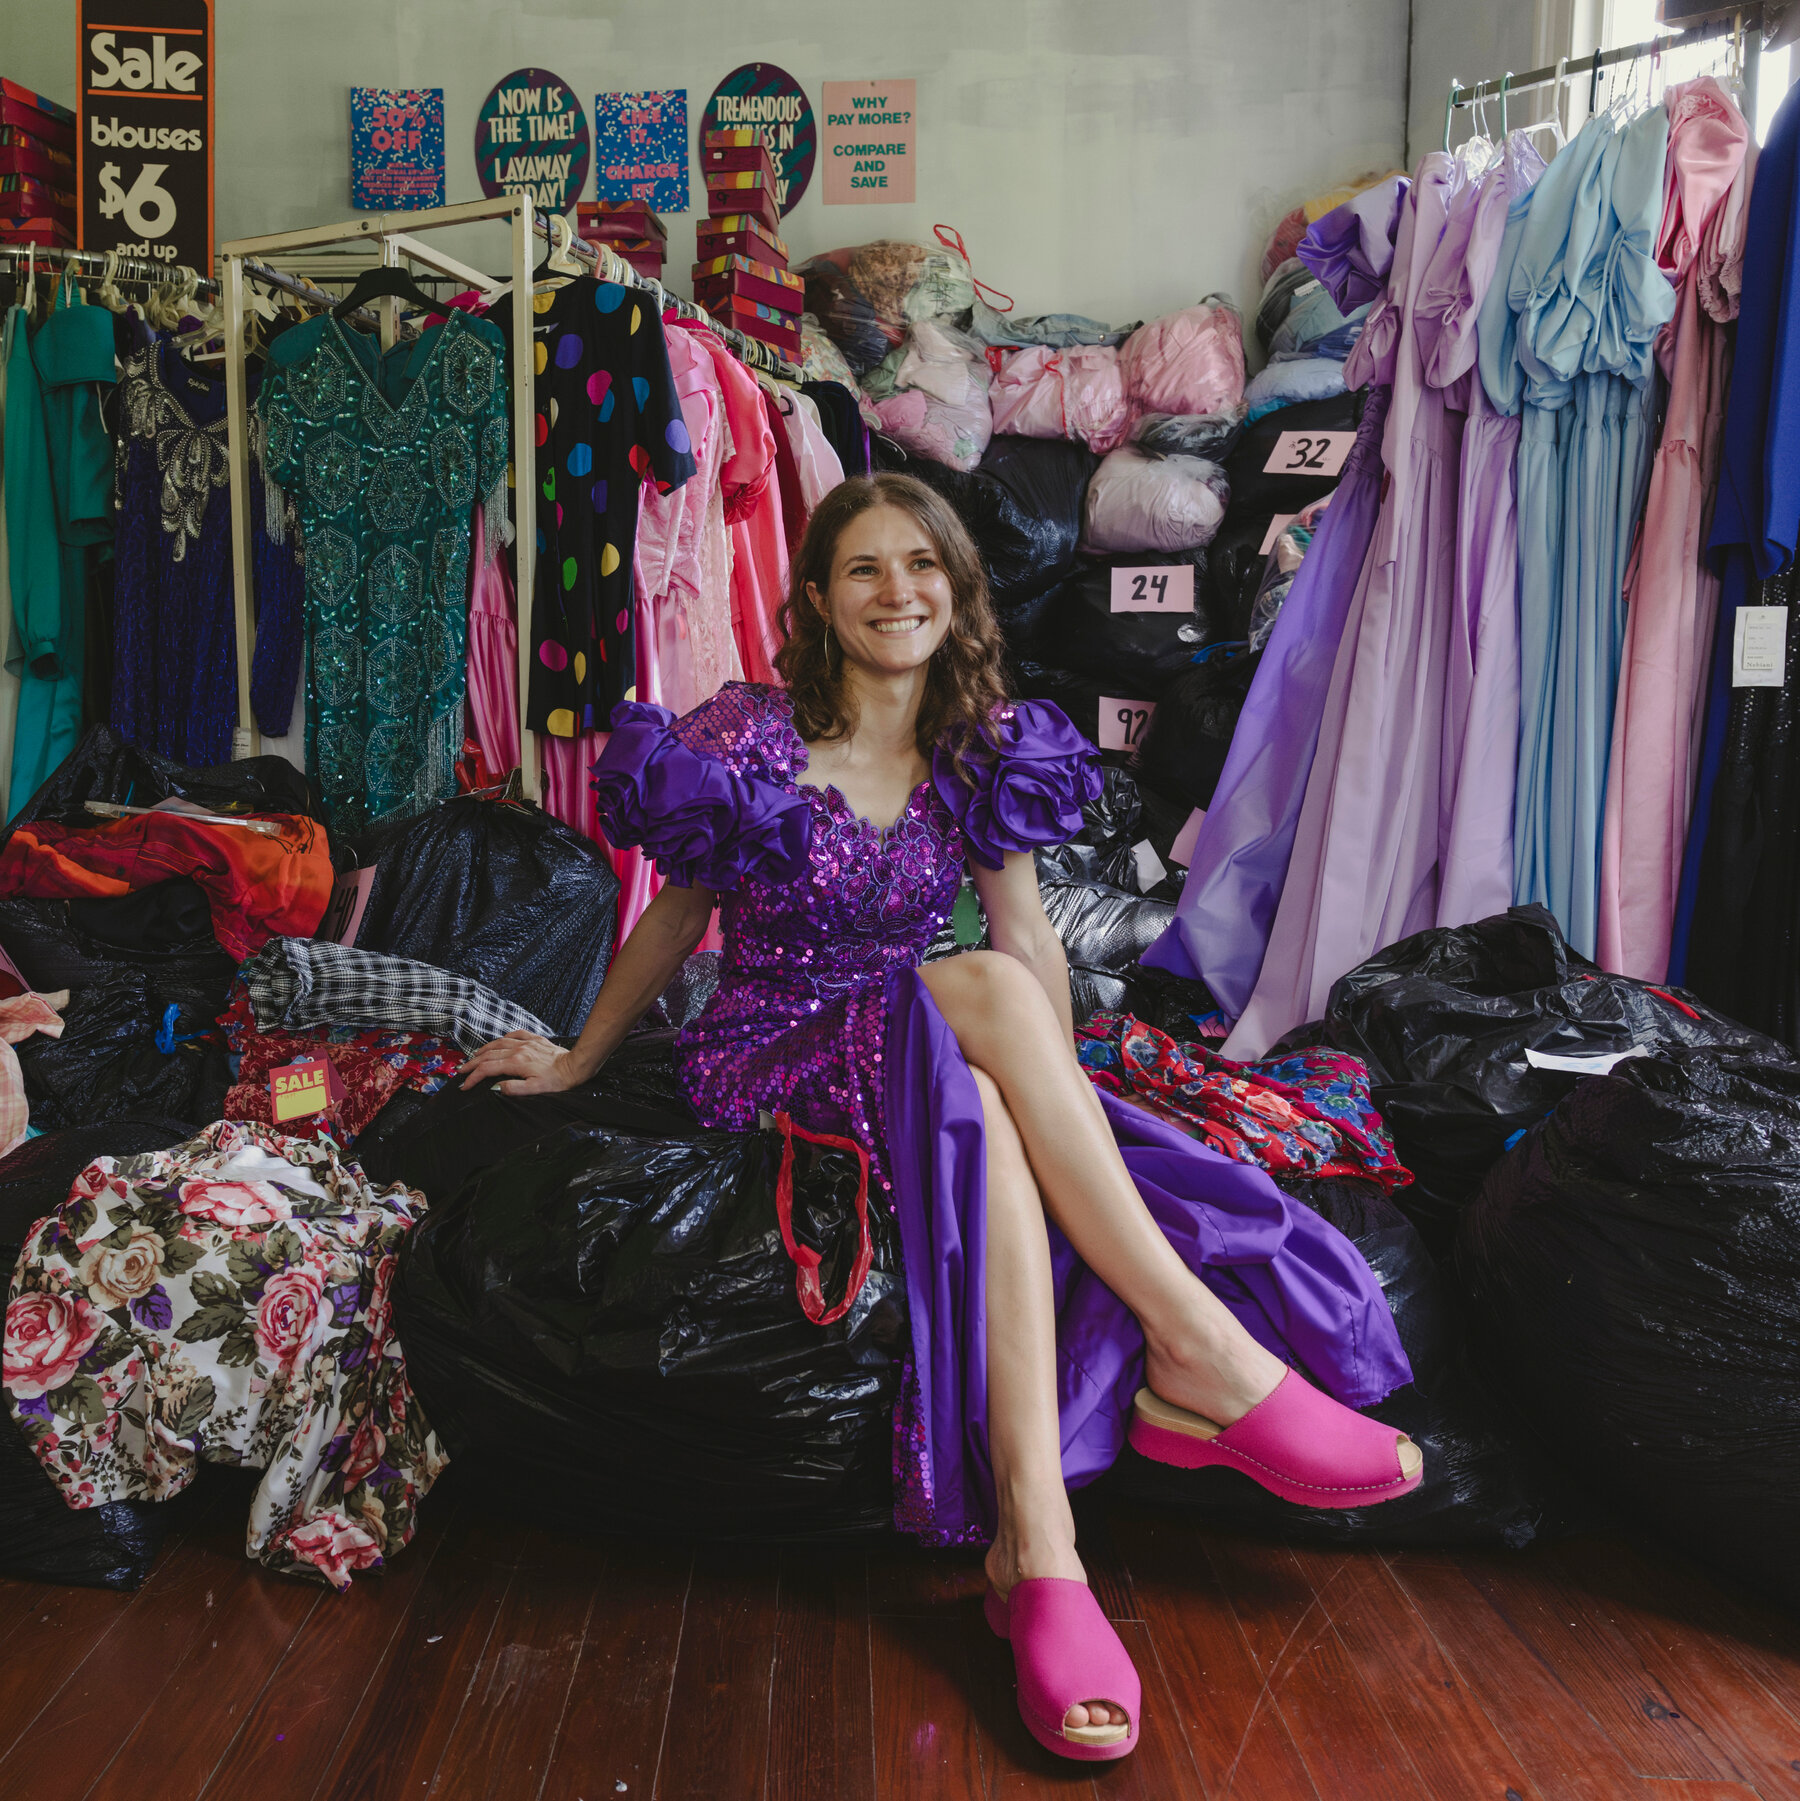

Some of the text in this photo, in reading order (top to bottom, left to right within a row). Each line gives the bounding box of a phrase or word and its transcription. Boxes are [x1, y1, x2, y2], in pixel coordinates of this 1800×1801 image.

[91, 32, 203, 92] Sale
[498, 86, 563, 115] NOW IS
[716, 96, 802, 122] TREMENDOUS
[852, 96, 888, 109] WHY
[372, 107, 426, 128] 50%
[488, 111, 575, 143] THE TIME!
[621, 109, 661, 125] LIKE
[827, 112, 911, 126] PAY MORE?
[91, 116, 202, 151] blouses
[371, 129, 421, 151] OFF
[630, 129, 652, 145] IT,
[779, 124, 794, 150] IN
[833, 143, 906, 157] COMPARE
[494, 154, 572, 183] LAYAWAY
[606, 163, 679, 180] CHARGE
[853, 160, 885, 172] AND
[850, 176, 888, 188] SAVE
[99, 161, 177, 239] $6
[116, 240, 178, 263] and up
[1286, 438, 1331, 469] 32
[1131, 574, 1168, 603] 24
[275, 1069, 324, 1093] SALE
